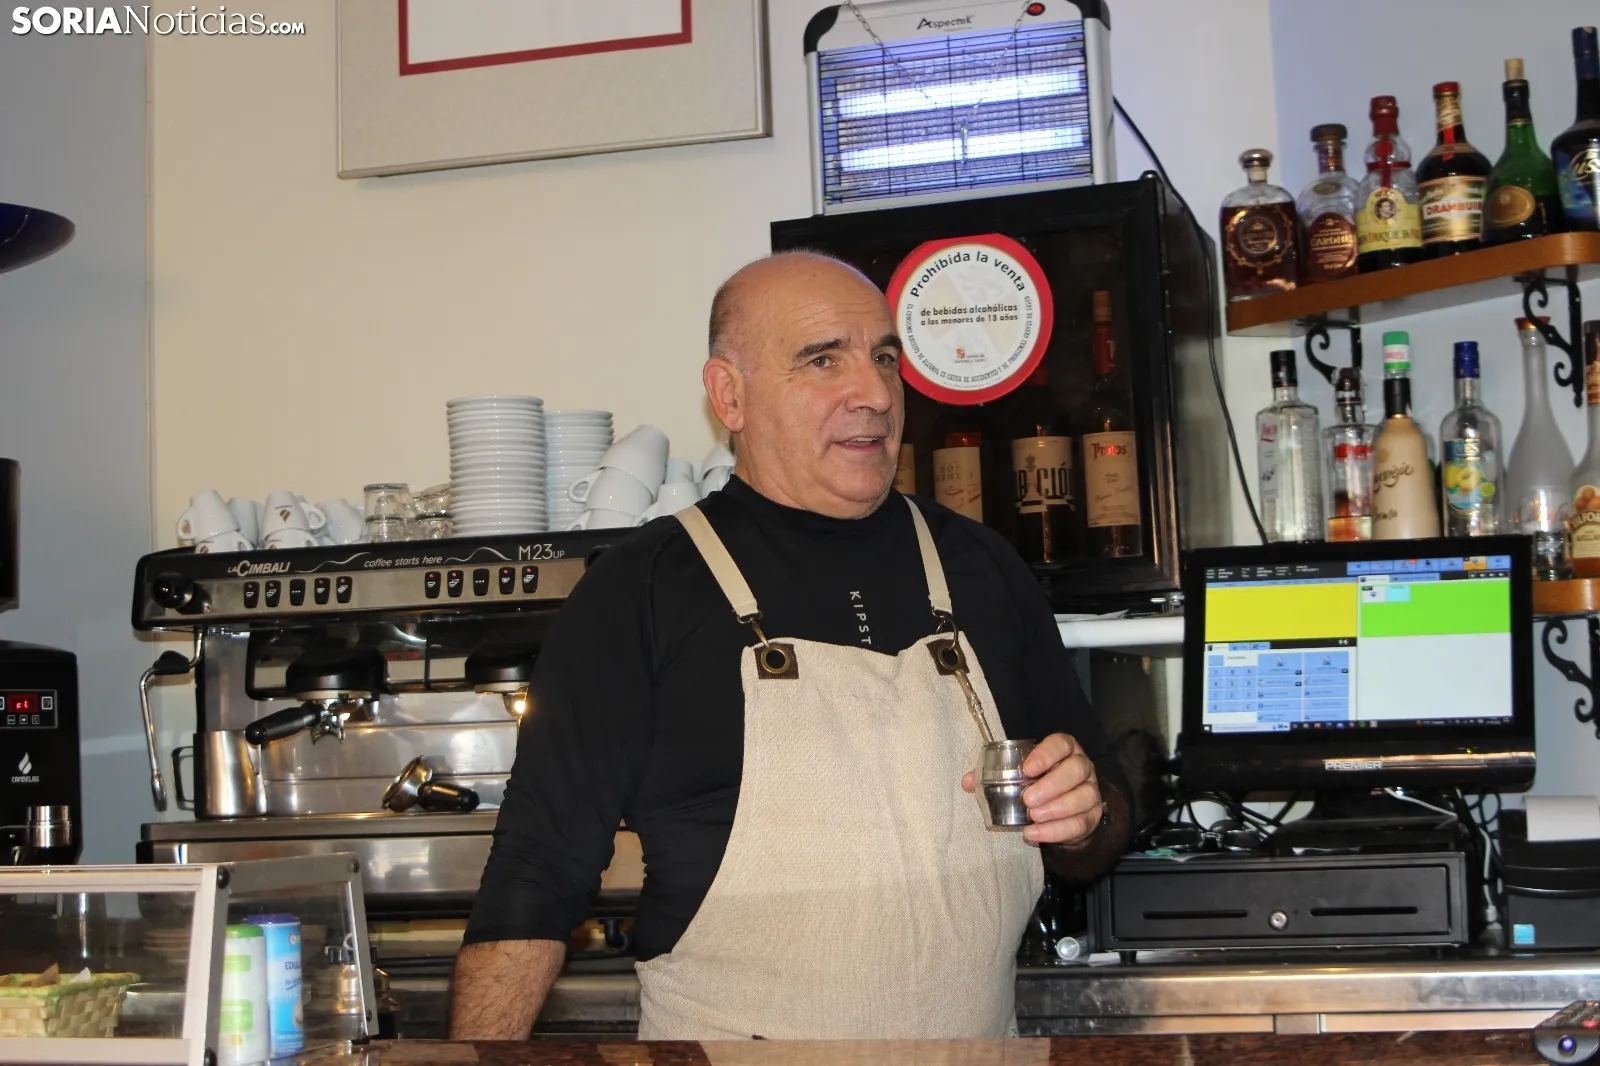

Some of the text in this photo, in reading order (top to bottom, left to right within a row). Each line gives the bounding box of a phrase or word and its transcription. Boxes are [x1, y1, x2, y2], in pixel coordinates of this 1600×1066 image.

[917, 15, 972, 30] Aspectek
[910, 251, 1025, 297] Prohibida la venta
[921, 304, 1018, 317] de bebidas alcohólicas
[927, 317, 939, 325] los
[941, 316, 974, 325] menores
[976, 315, 985, 323] de
[987, 314, 997, 322] 18
[364, 555, 443, 568] coffee starts here
[237, 560, 291, 577] CIMBALI
[849, 590, 872, 645] KIPST
[1324, 760, 1382, 771] PREMIER
[11, 775, 40, 783] CANDELAS
